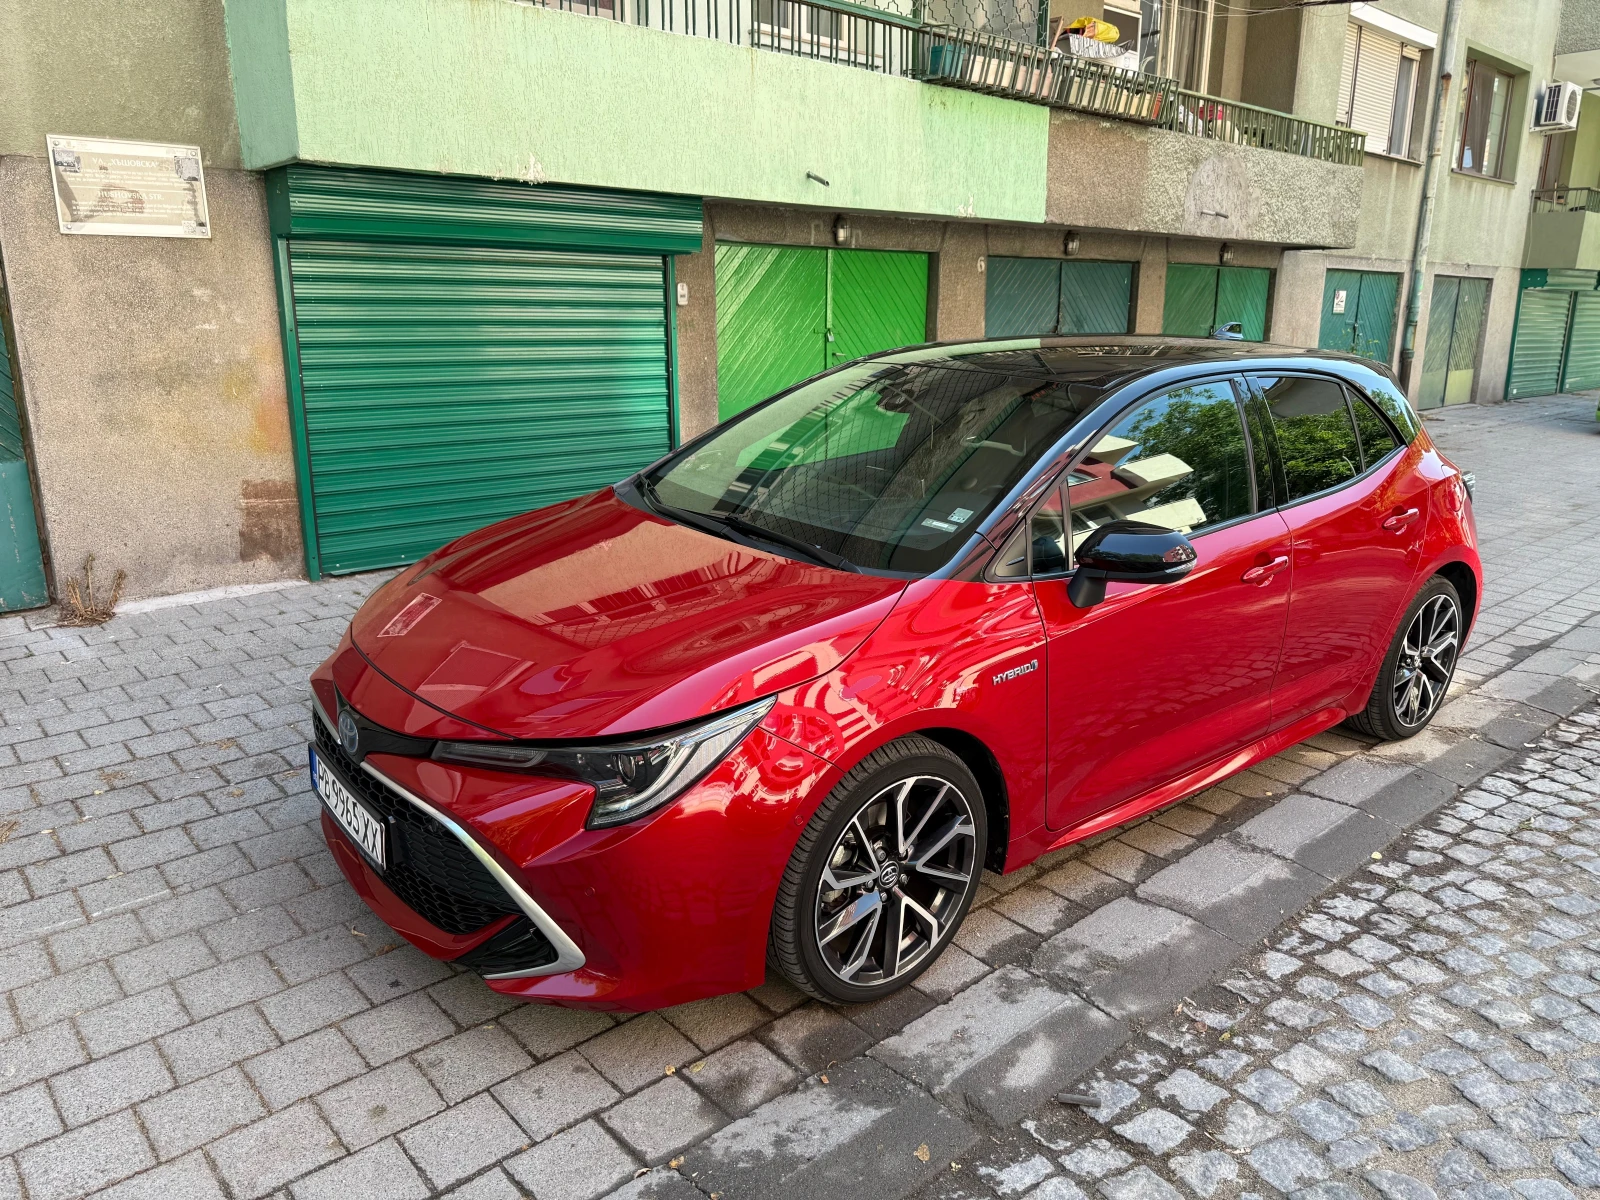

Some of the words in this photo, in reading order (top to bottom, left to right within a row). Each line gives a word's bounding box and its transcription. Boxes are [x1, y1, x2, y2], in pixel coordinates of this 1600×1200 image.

[98, 191, 147, 200] HUSHOVSKA
[149, 193, 165, 201] STR.
[977, 256, 986, 273] 6
[992, 662, 1032, 686] HYBRID
